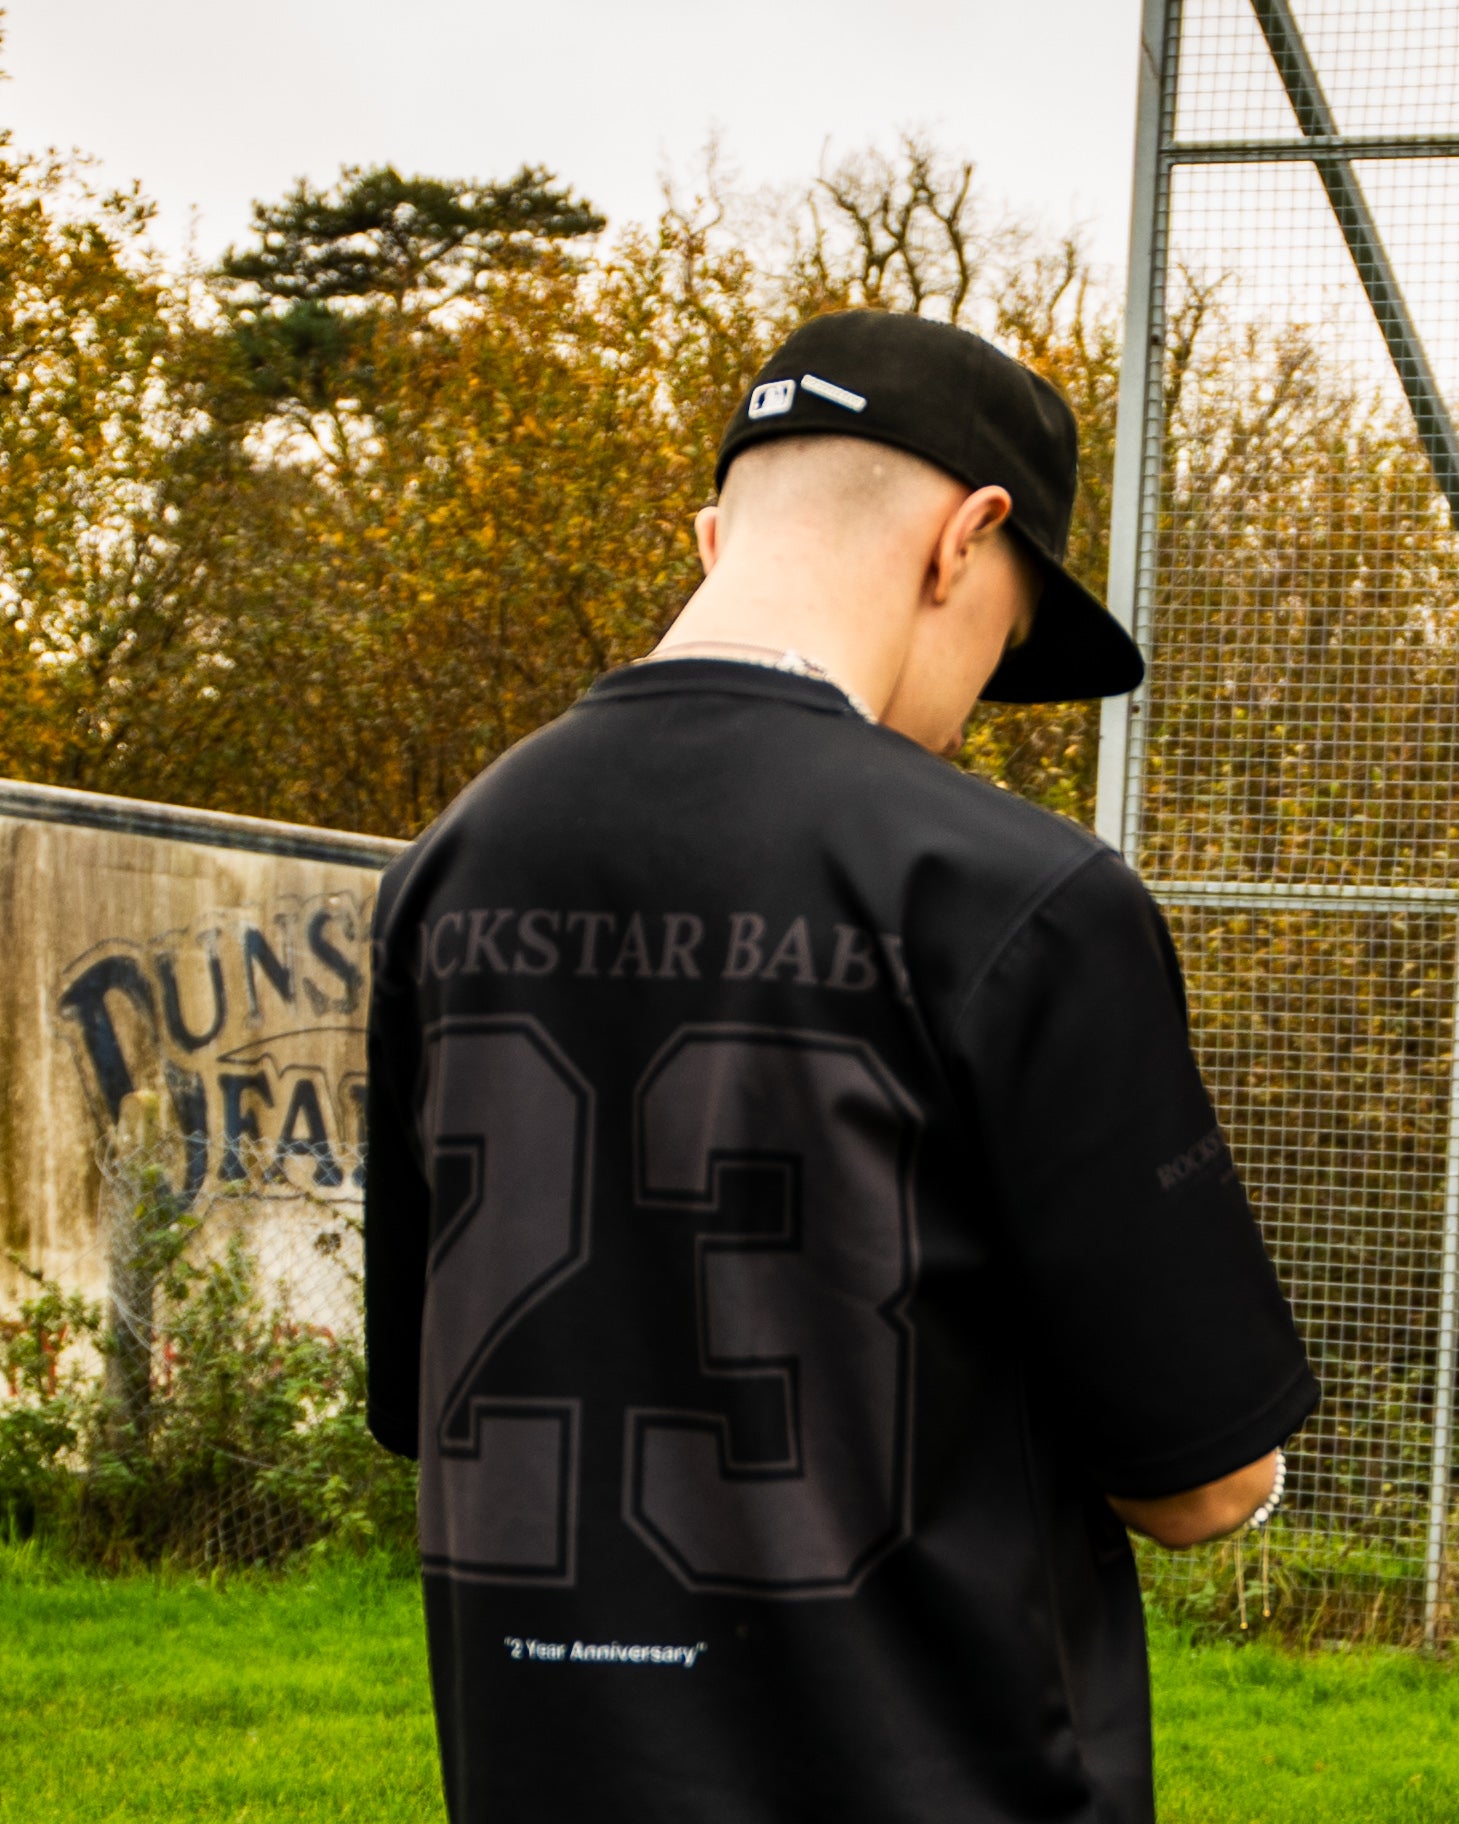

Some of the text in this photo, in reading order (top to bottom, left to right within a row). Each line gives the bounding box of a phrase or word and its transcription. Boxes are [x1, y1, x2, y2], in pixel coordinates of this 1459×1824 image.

[58, 902, 370, 1210] DUNS
[418, 1013, 924, 1600] 23
[525, 1638, 567, 1661] Year
